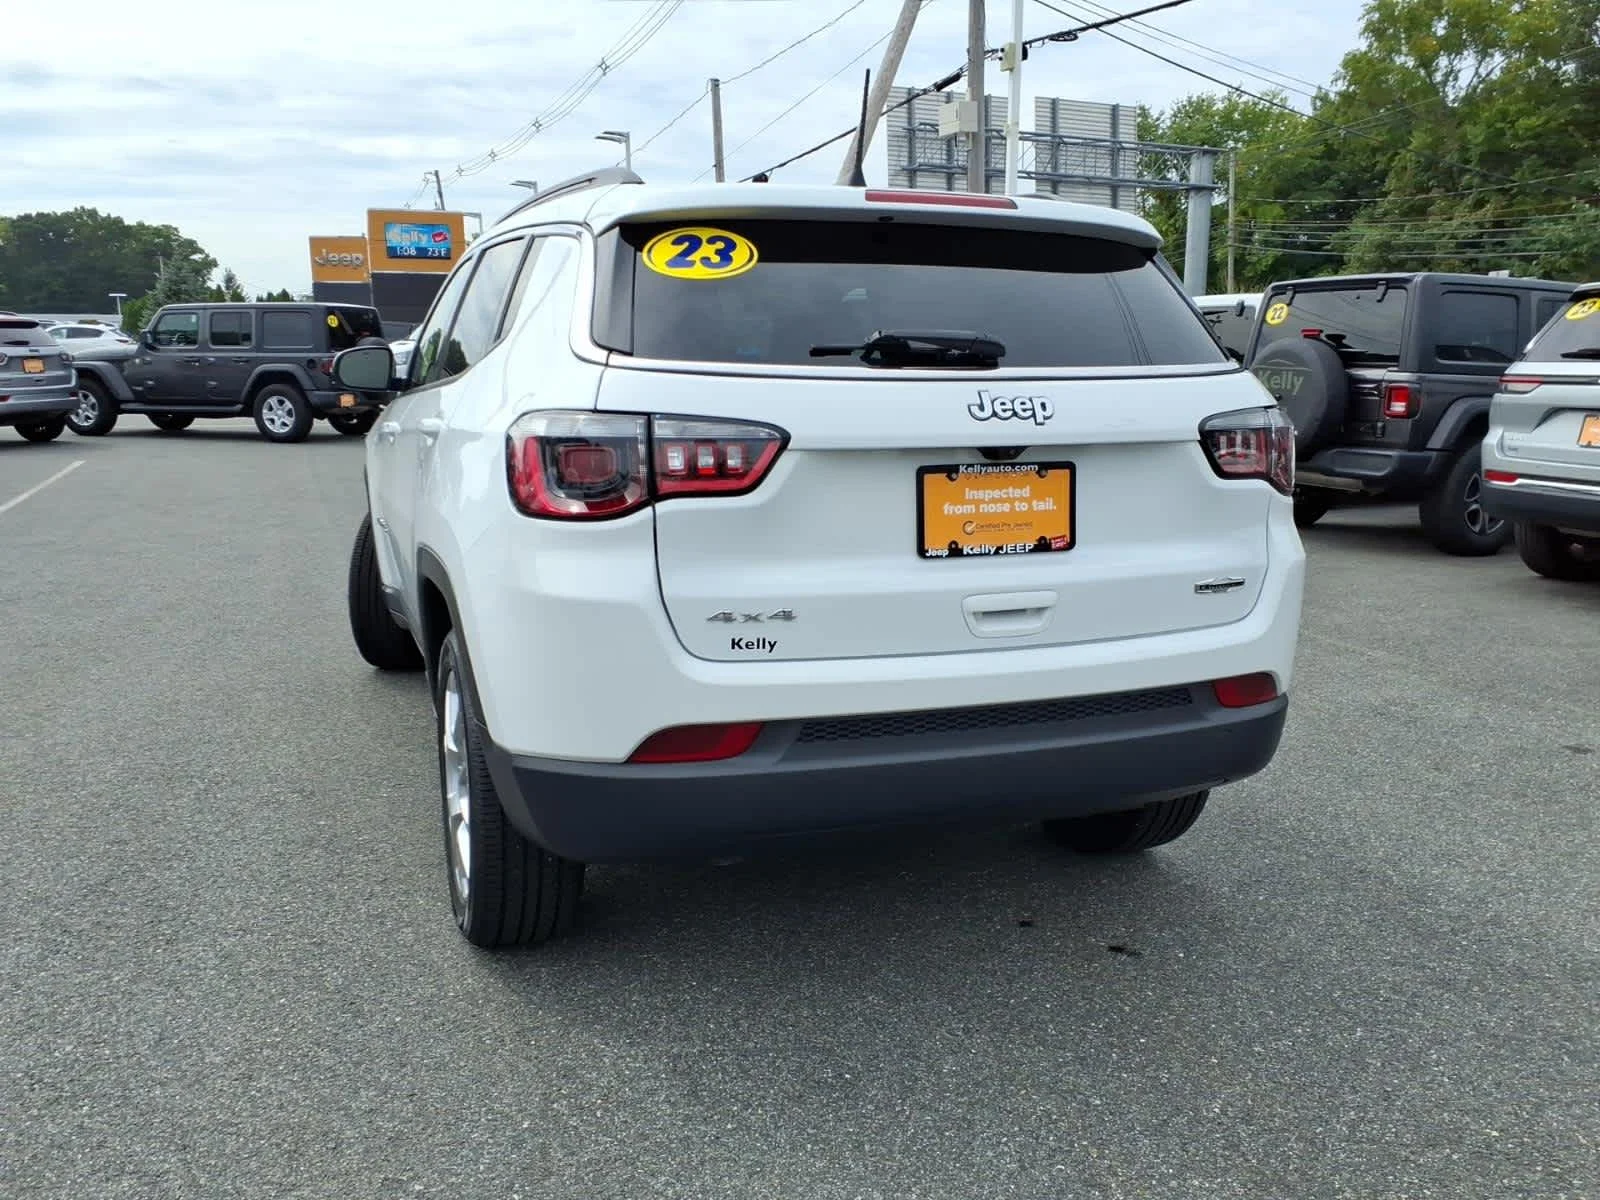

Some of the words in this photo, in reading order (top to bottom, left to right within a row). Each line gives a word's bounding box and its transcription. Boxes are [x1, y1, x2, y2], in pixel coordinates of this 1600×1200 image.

[315, 248, 364, 268] Jeep
[665, 234, 737, 269] 23
[1259, 370, 1304, 395] Kelly
[967, 390, 1055, 426] Jeep
[959, 465, 1039, 474] Kellyauto.com
[965, 485, 1031, 501] Inspected
[943, 503, 976, 515] from
[979, 502, 1010, 513] nose
[1014, 500, 1029, 512] to
[1032, 497, 1057, 511] tail.
[925, 548, 949, 558] Jeep
[962, 544, 997, 556] Kelly
[998, 543, 1035, 554] JEEP
[730, 637, 778, 654] Kelly
